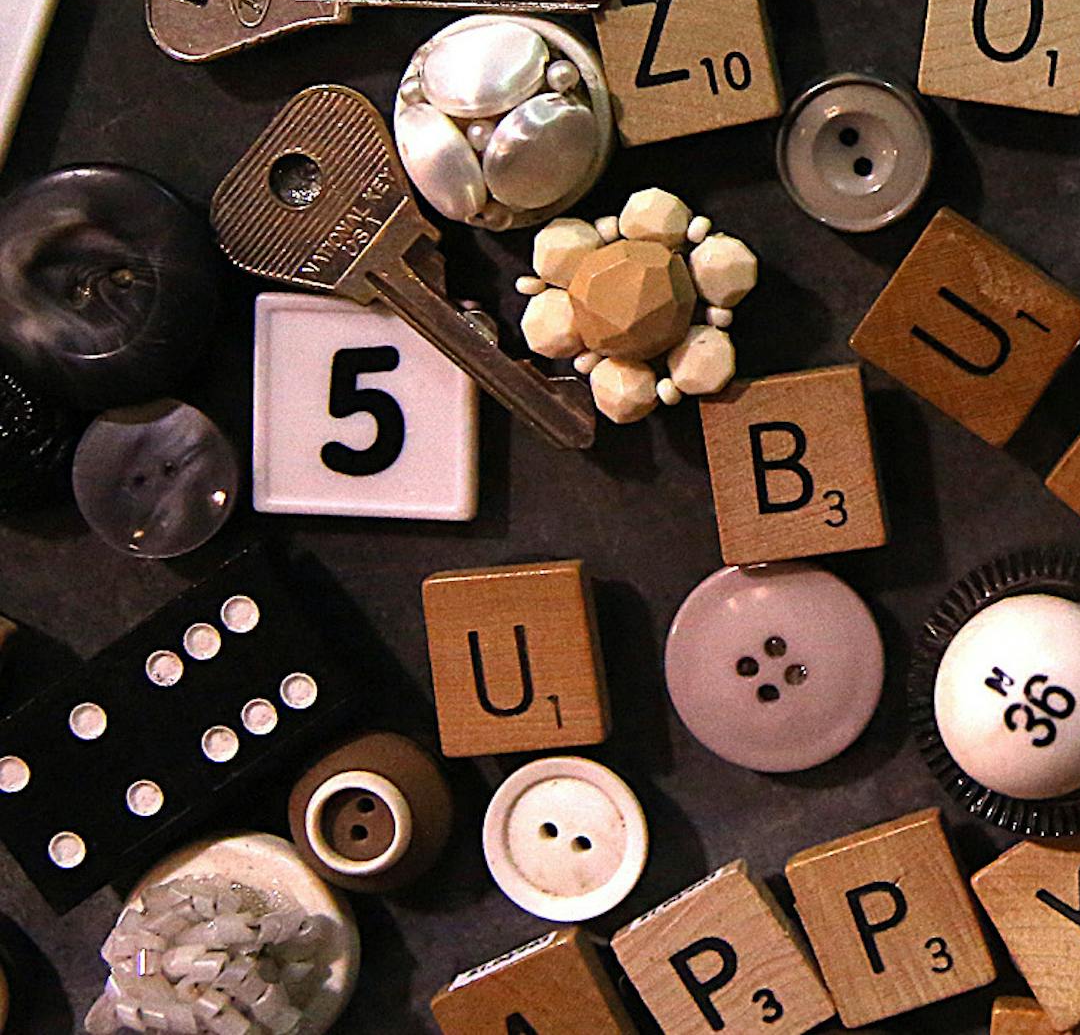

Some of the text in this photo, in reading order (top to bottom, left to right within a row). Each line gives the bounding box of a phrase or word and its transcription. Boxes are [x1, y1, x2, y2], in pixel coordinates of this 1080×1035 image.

[910, 287, 1011, 377] U
[321, 346, 405, 477] 5
[749, 421, 814, 514] B
[468, 625, 534, 717] U
[1004, 675, 1076, 748] 36
[845, 878, 907, 974] P
[668, 937, 737, 1032] P
